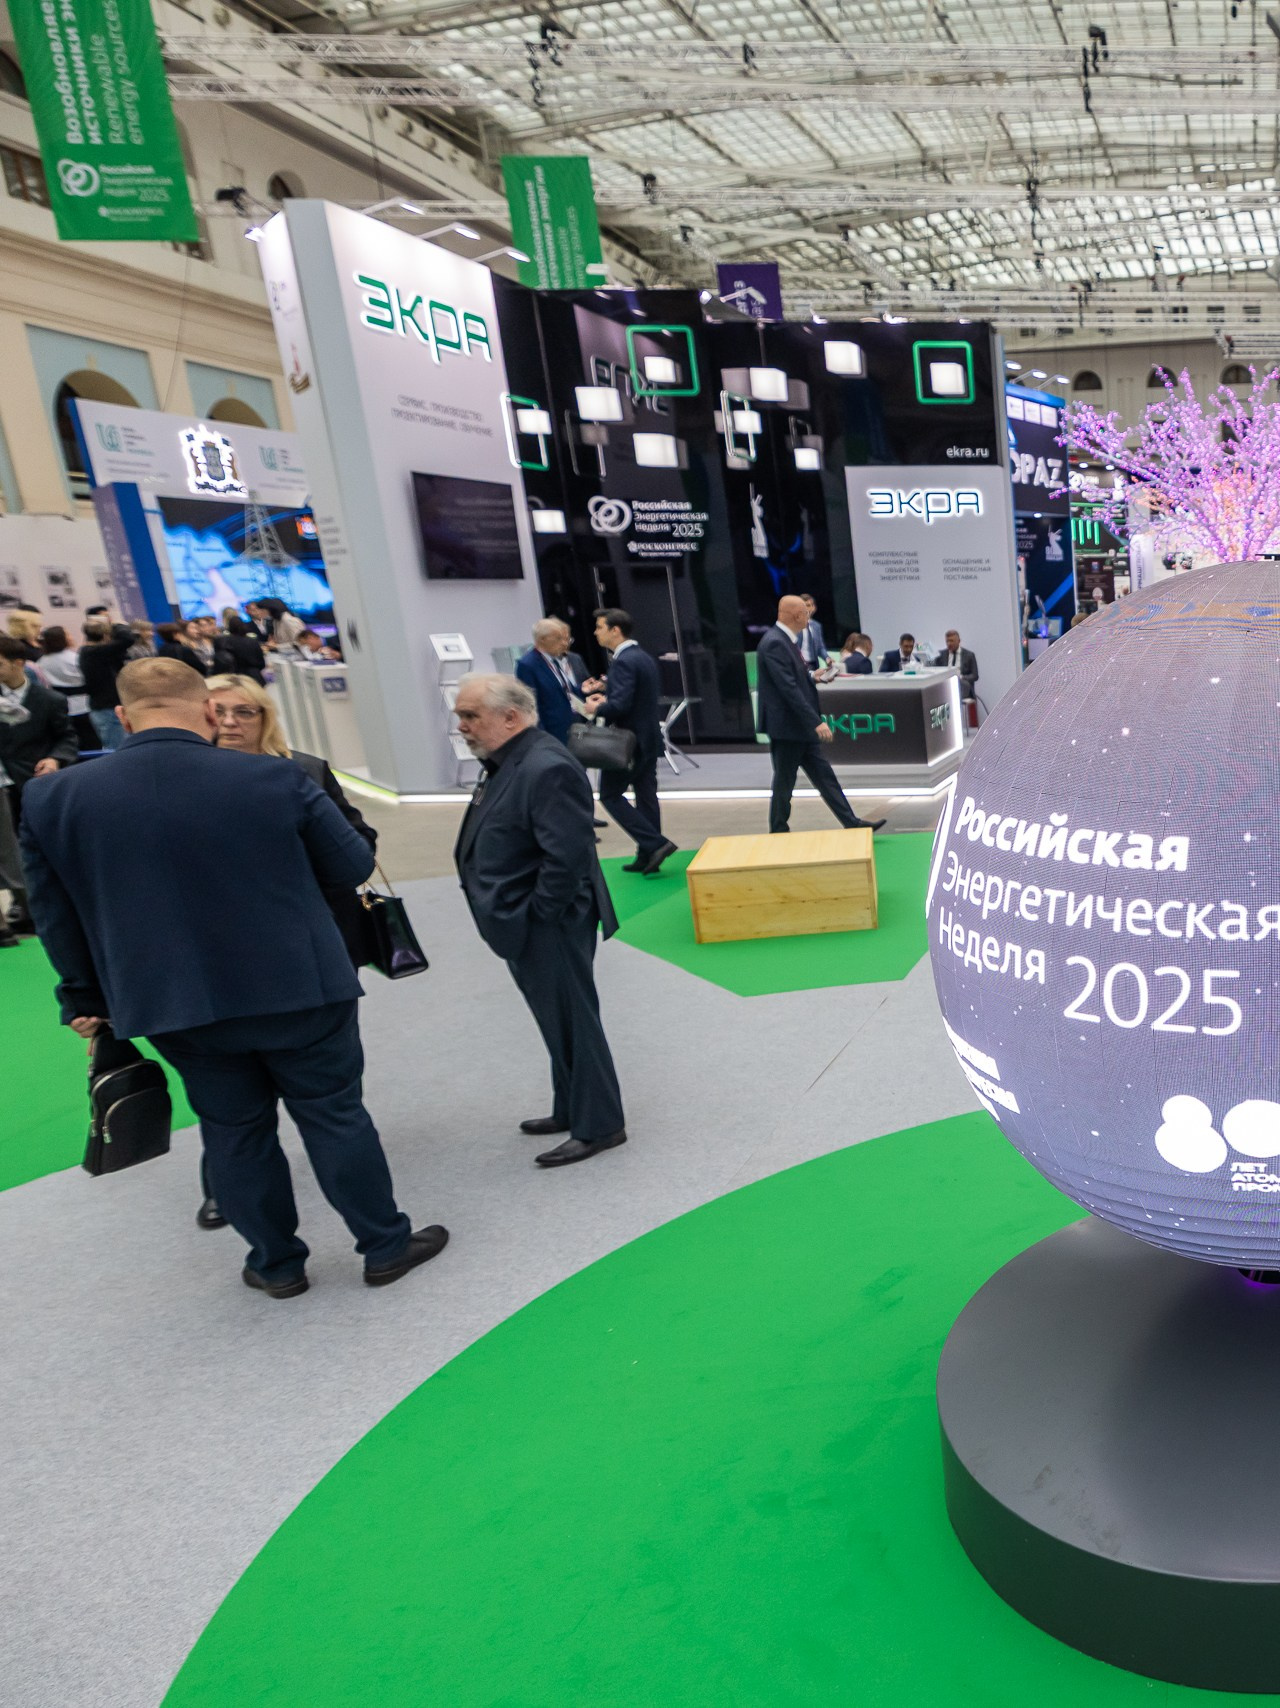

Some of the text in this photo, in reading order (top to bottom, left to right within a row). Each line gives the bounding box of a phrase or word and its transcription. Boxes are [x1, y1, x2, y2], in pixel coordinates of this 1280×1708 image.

[41, 0, 84, 144] Возобновляе
[65, 27, 104, 145] источники
[90, 34, 126, 144] Renewable
[120, 78, 145, 145] energy
[353, 270, 493, 365] ЭКРА
[946, 445, 990, 458] ekra.ru
[631, 499, 693, 511] Российская
[633, 511, 709, 523] Энергетическая
[867, 488, 983, 525] ЭКРА
[636, 542, 698, 551] РОСКОНГРЕСС
[671, 523, 705, 537] 2025
[821, 713, 895, 740] КРА
[955, 796, 1190, 872] Российская
[938, 906, 1243, 1036] Неделя 2025
[1230, 1162, 1268, 1173] ЛЕТ
